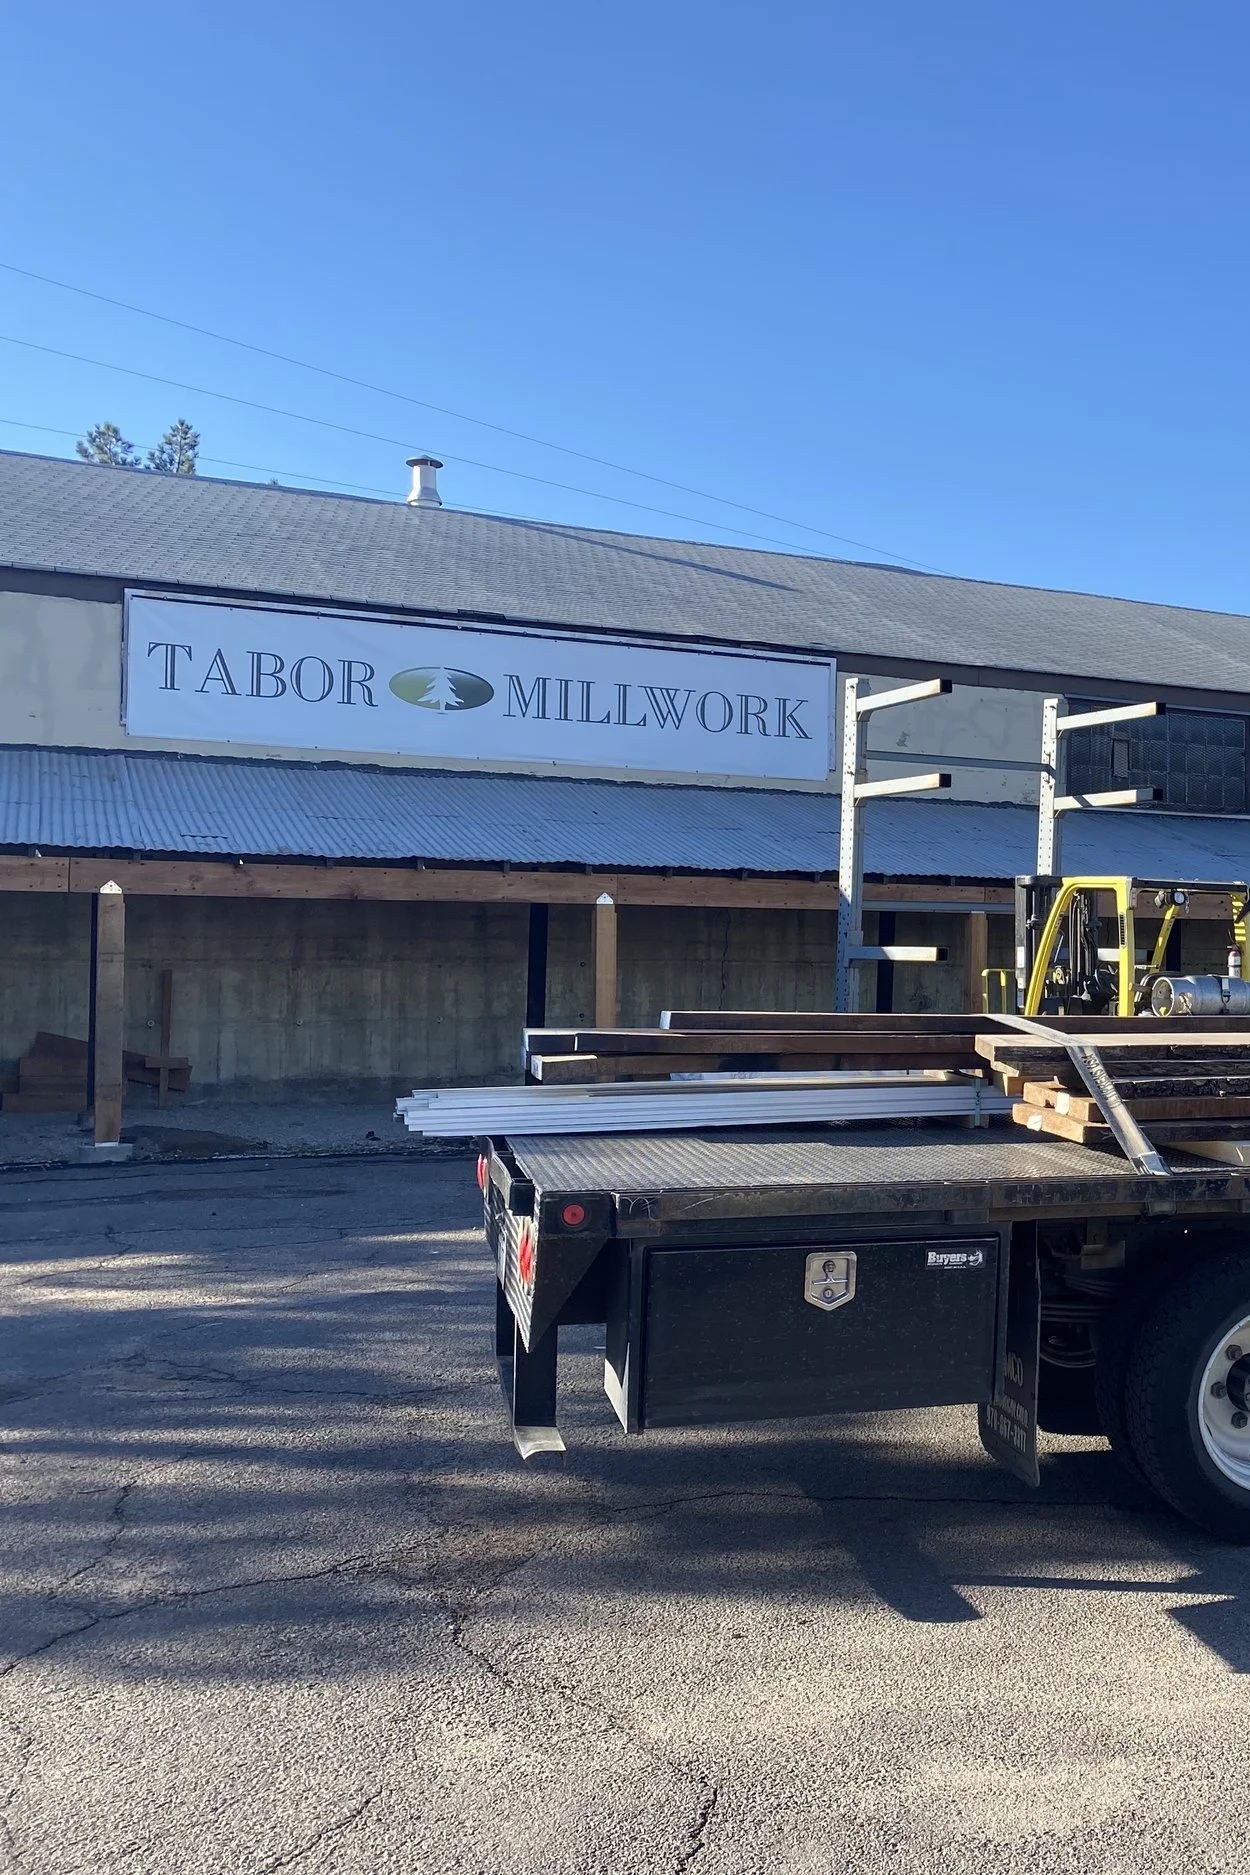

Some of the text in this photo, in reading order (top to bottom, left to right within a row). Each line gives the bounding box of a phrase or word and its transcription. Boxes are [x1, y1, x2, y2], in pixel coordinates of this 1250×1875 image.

[147, 641, 813, 740] TABOR MILLWORK
[928, 1251, 967, 1265] Buyers
